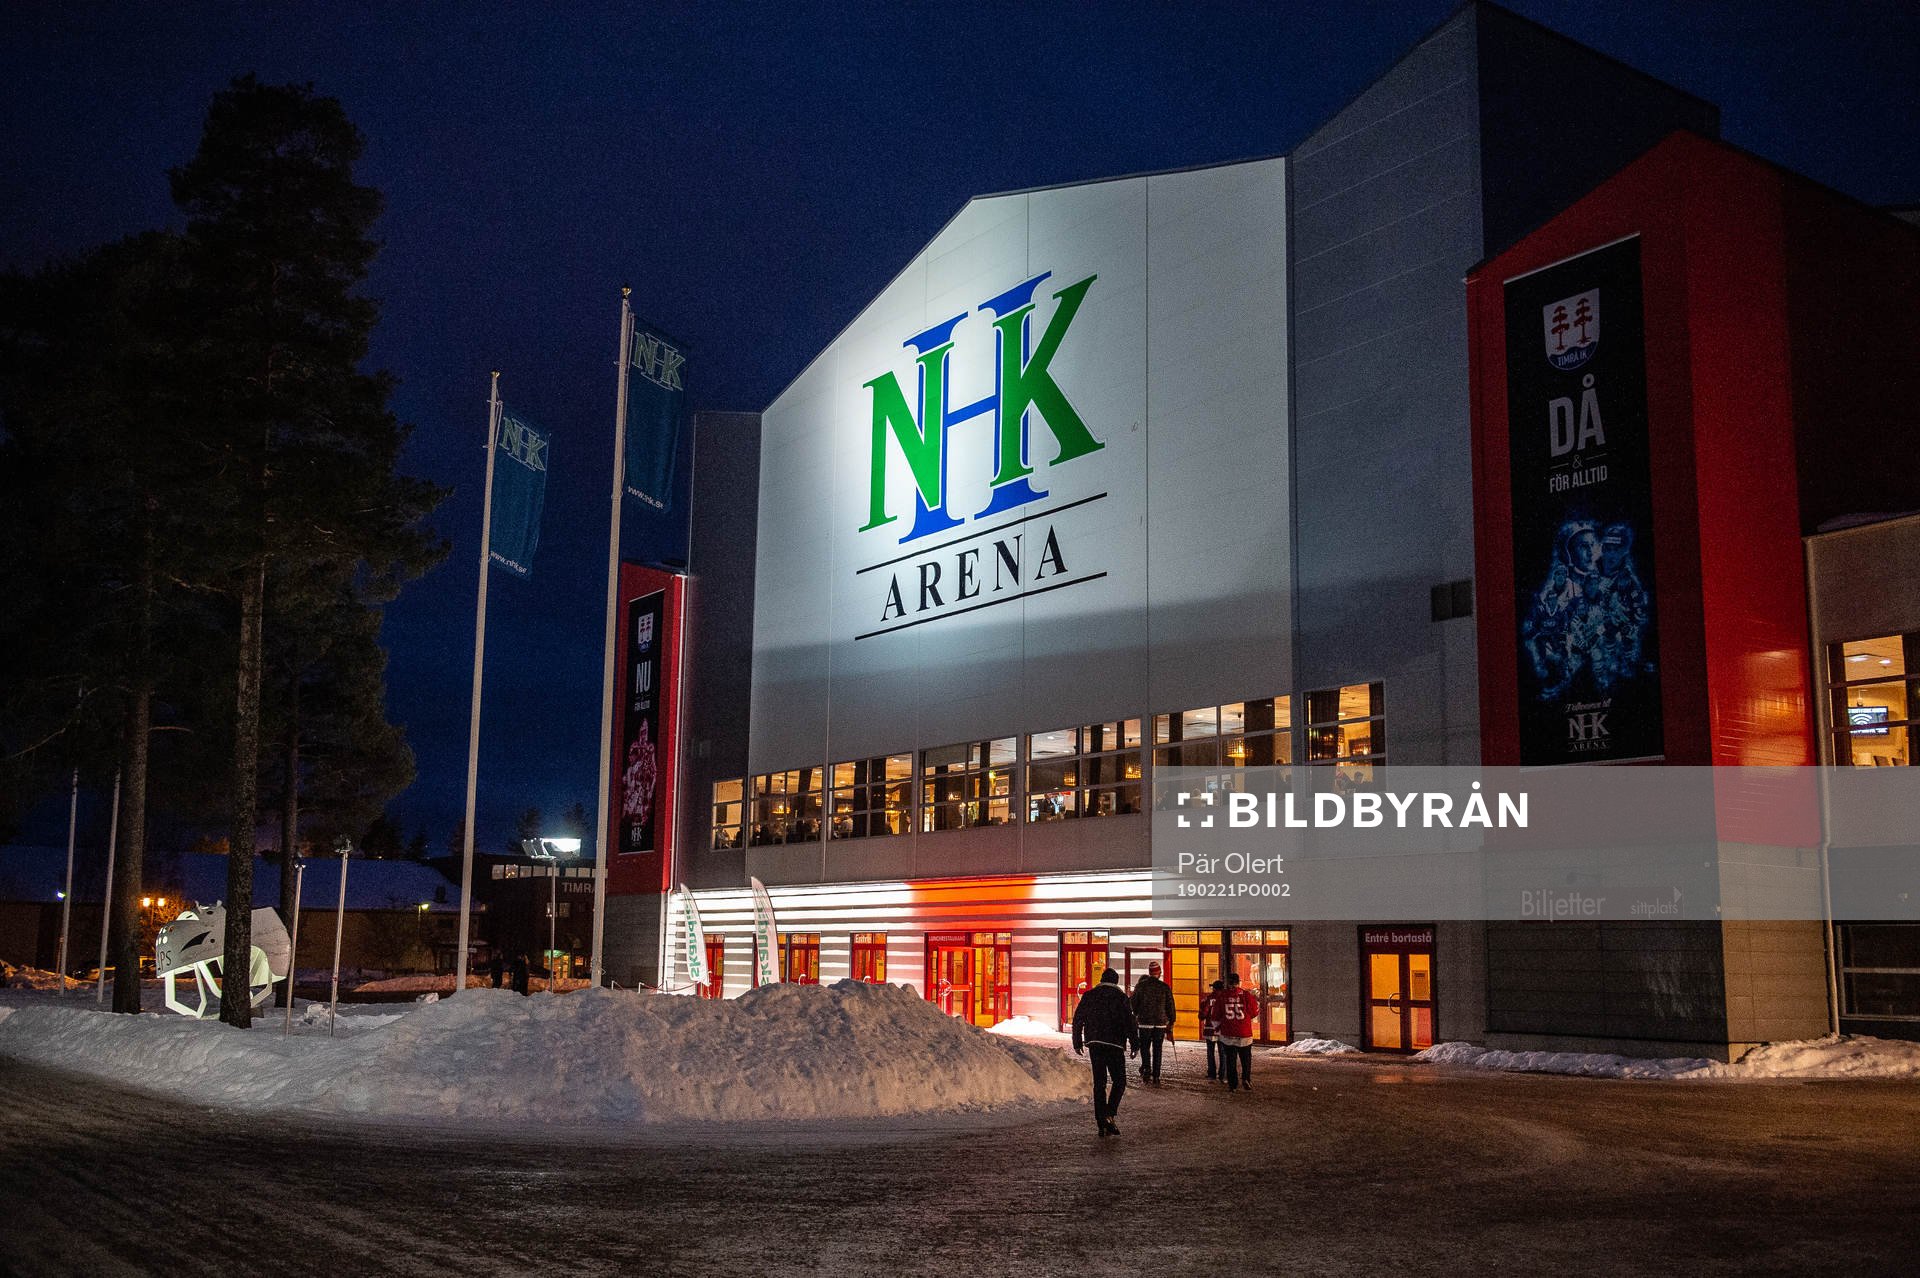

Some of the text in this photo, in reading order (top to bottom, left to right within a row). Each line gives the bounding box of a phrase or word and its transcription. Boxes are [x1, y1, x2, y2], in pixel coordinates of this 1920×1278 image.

[632, 332, 686, 391] NHK
[858, 271, 1105, 545] NHK
[1549, 373, 1606, 457] DÅ
[499, 417, 547, 472] NHK
[1572, 454, 1584, 469] &
[1550, 465, 1608, 494] FÖR ALLTID
[880, 525, 1069, 622] ARENA
[635, 659, 651, 694] NU
[1568, 711, 1611, 742] NHK
[561, 882, 595, 893] TIMR
[1521, 888, 1679, 923] Biljetter sittplats
[1364, 931, 1432, 943] Entré bortastå
[1225, 1003, 1244, 1020] 55
